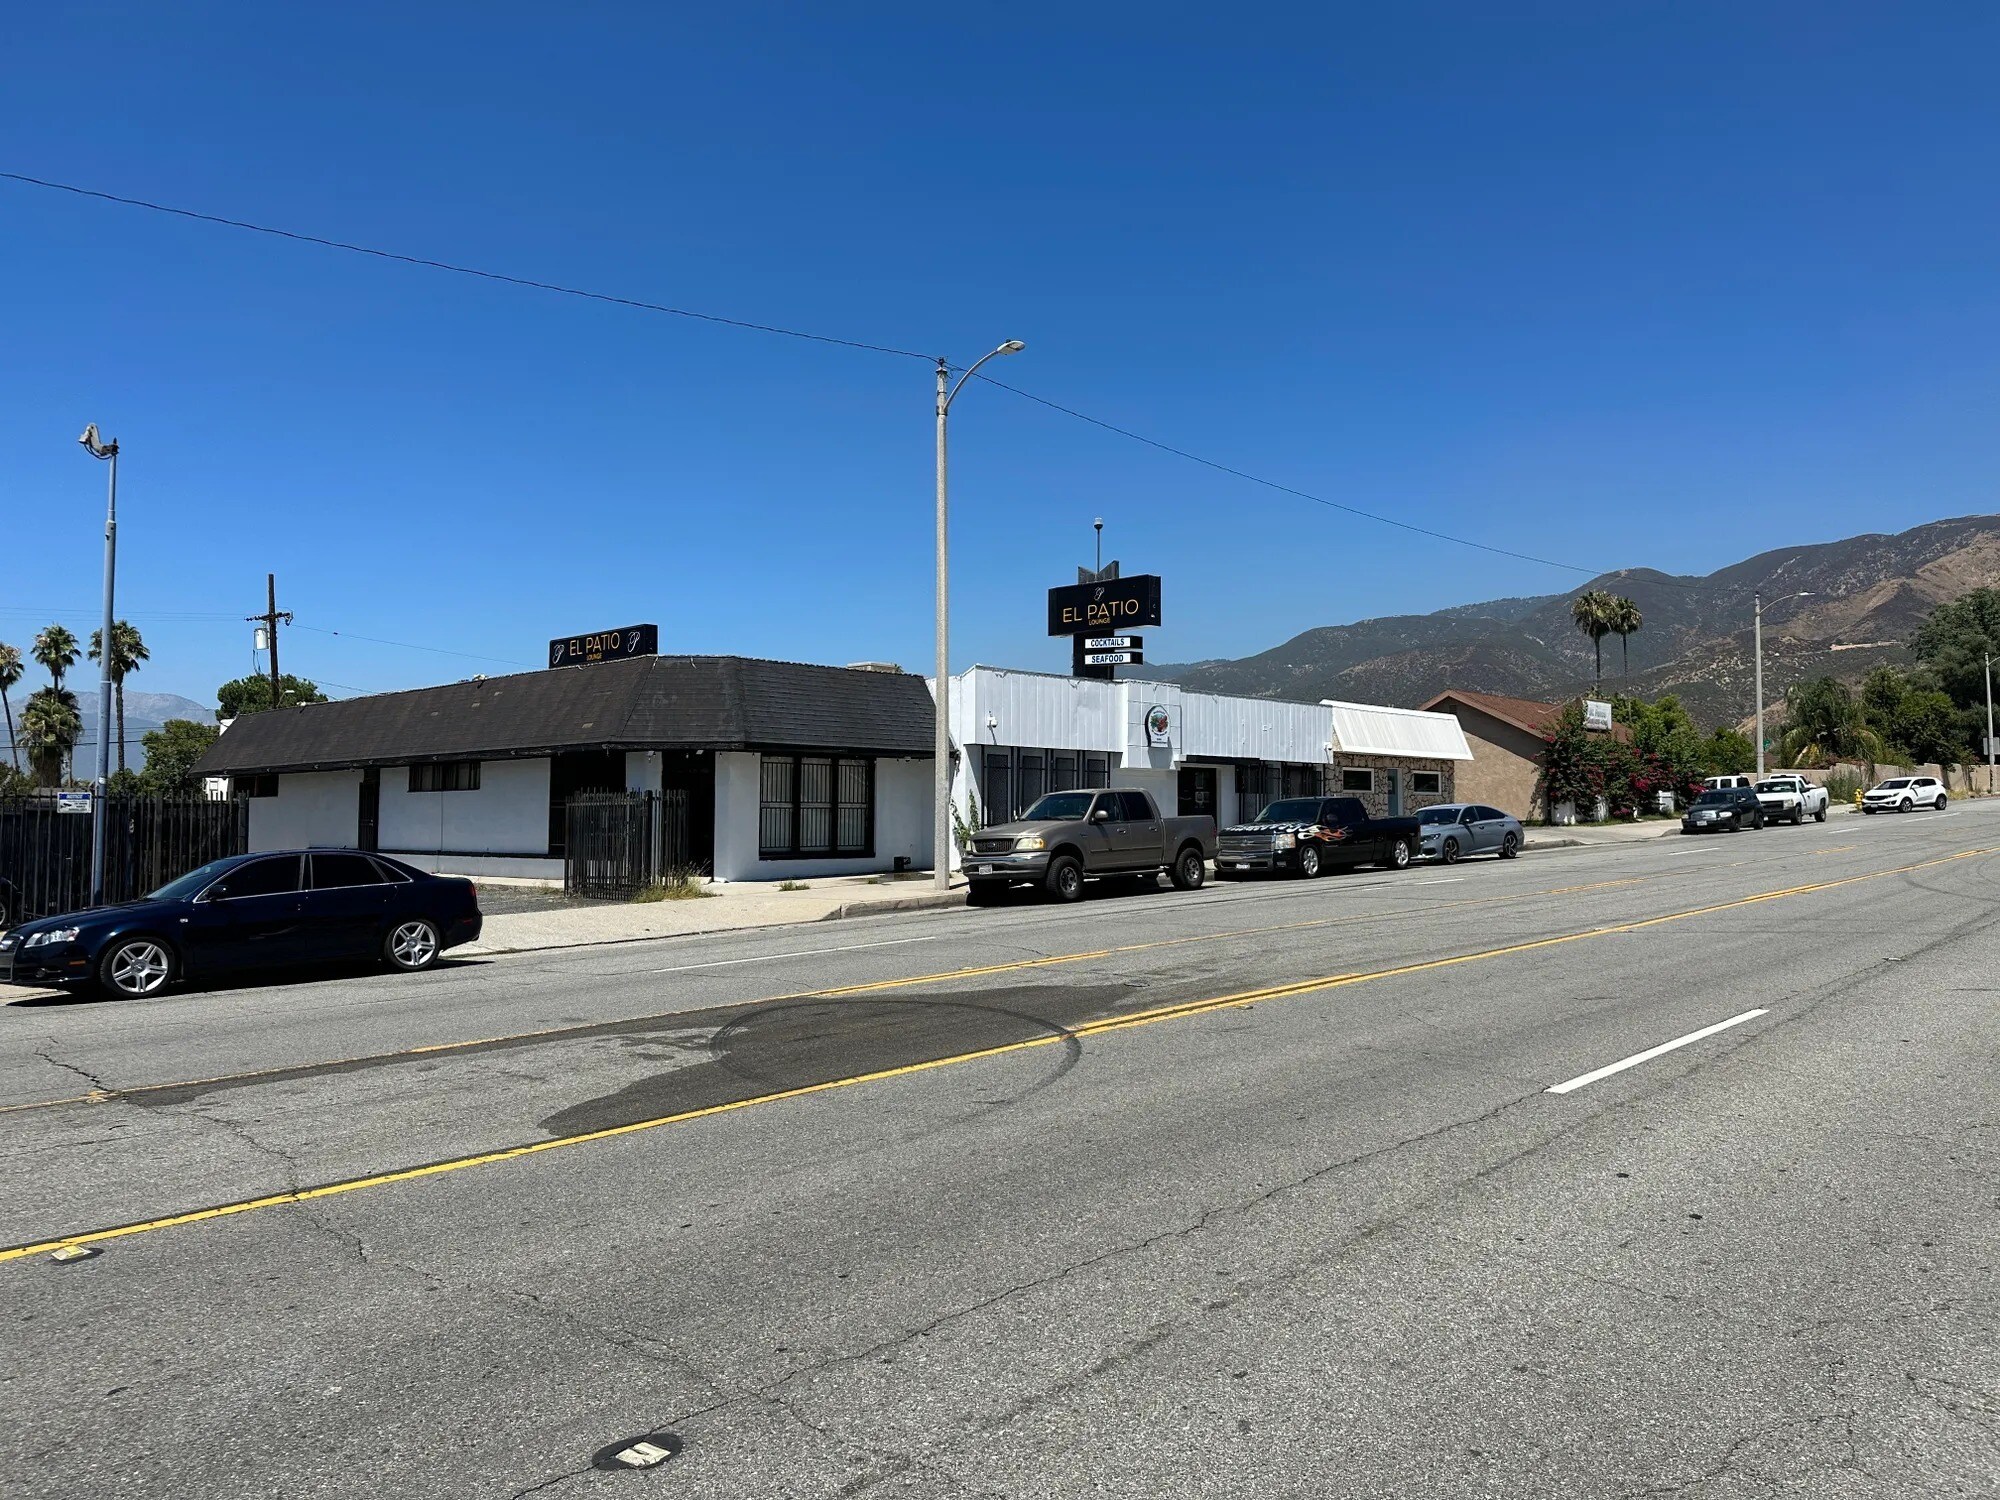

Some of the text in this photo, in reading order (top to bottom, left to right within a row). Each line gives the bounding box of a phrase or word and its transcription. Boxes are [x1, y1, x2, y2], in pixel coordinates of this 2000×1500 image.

[1062, 599, 1139, 623] EL PATIO
[1088, 618, 1111, 626] LOUNGE
[569, 632, 620, 656] EL PATIO
[1090, 637, 1125, 648] COCKTAILS
[1091, 654, 1124, 664] SEAFOOD
